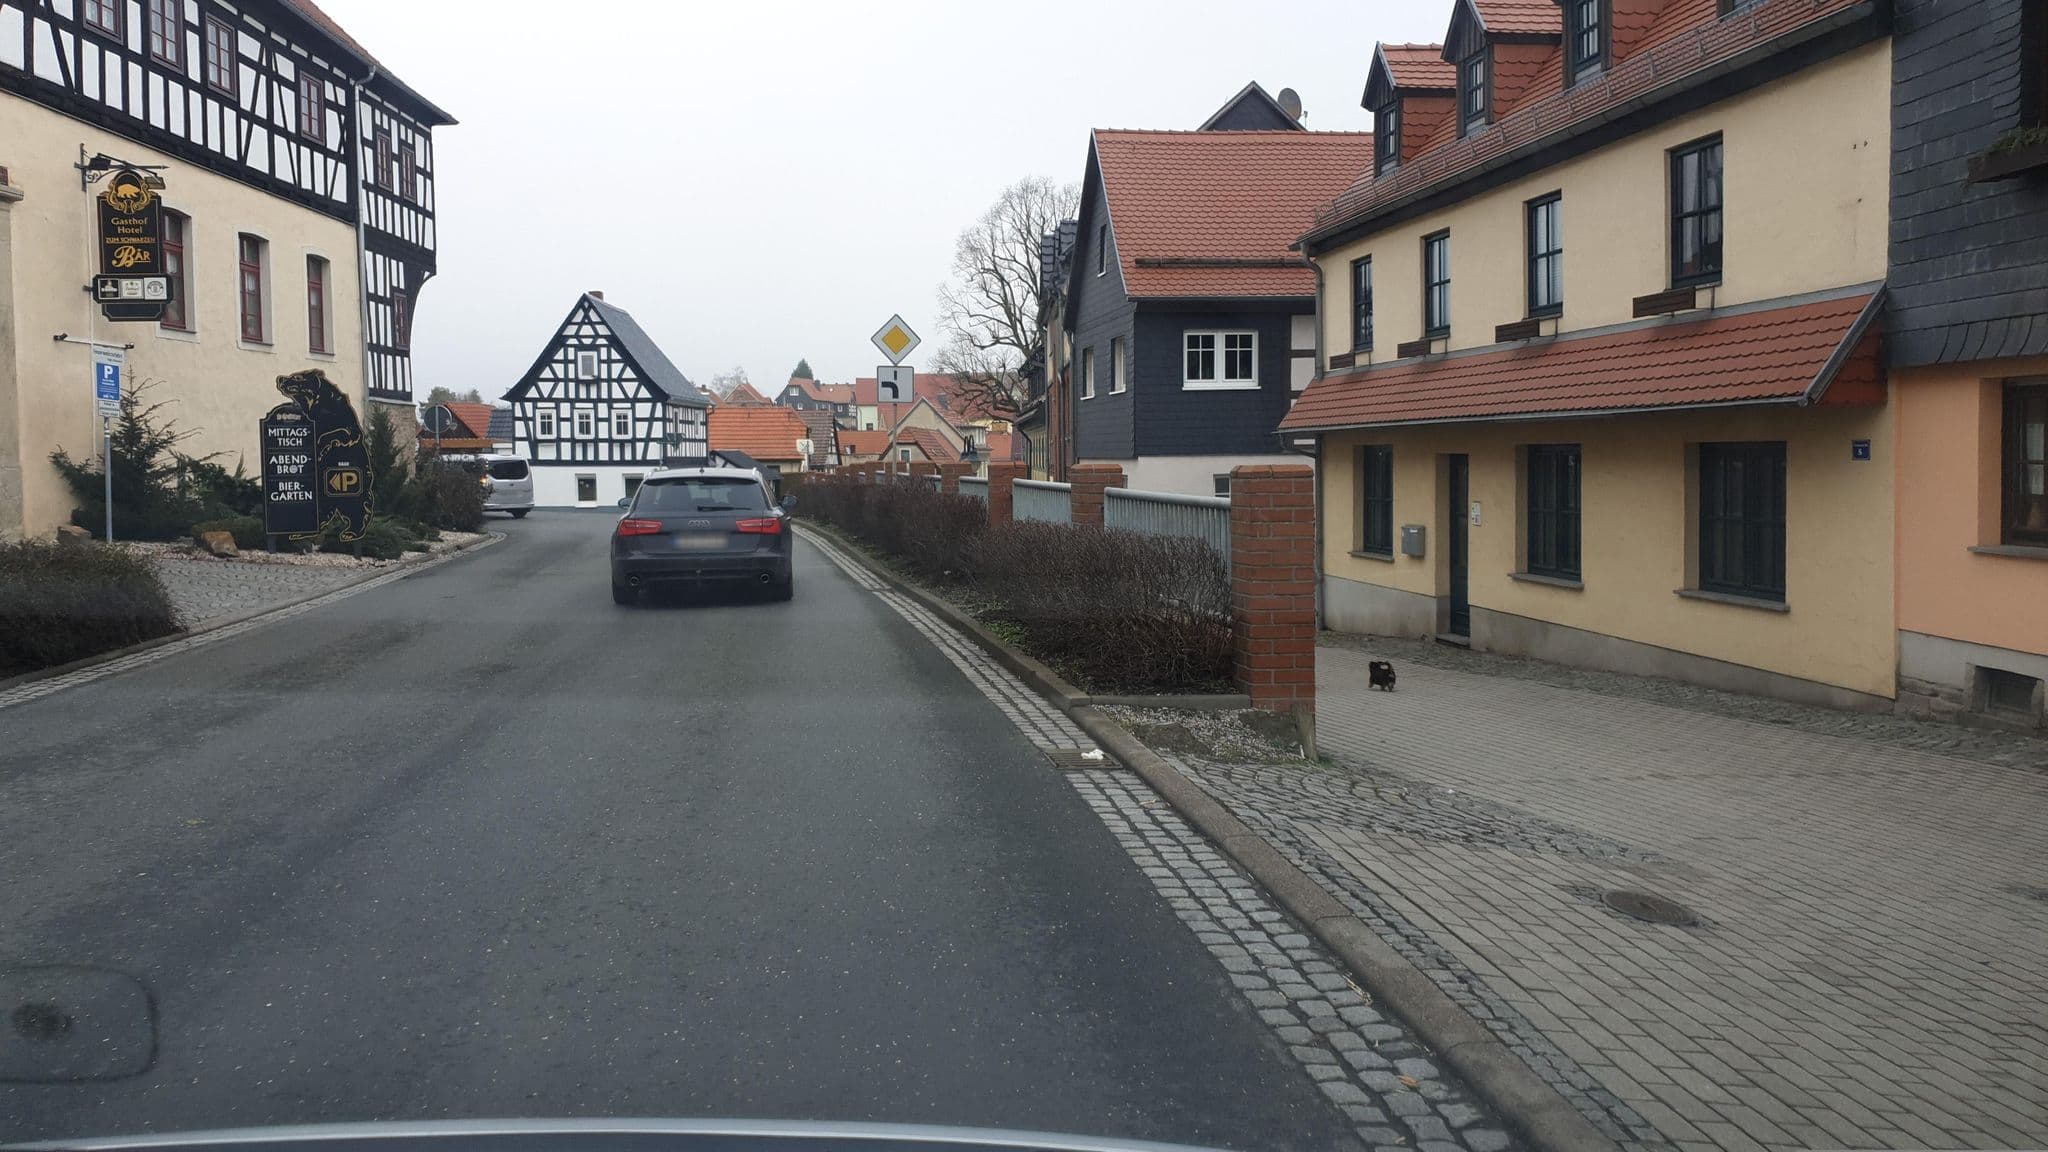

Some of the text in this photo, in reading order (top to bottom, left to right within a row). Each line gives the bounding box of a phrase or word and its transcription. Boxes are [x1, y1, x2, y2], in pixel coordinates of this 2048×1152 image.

[111, 217, 148, 225] Gasthof
[118, 226, 143, 234] Hotel
[104, 365, 113, 379] P
[268, 428, 311, 437] MITTAGS-
[277, 437, 303, 447] TISCH
[269, 455, 312, 465] ABEND-
[277, 465, 304, 474] BROT
[278, 482, 304, 491] BIER-
[343, 472, 358, 492] P
[270, 491, 313, 501] GARTEN
